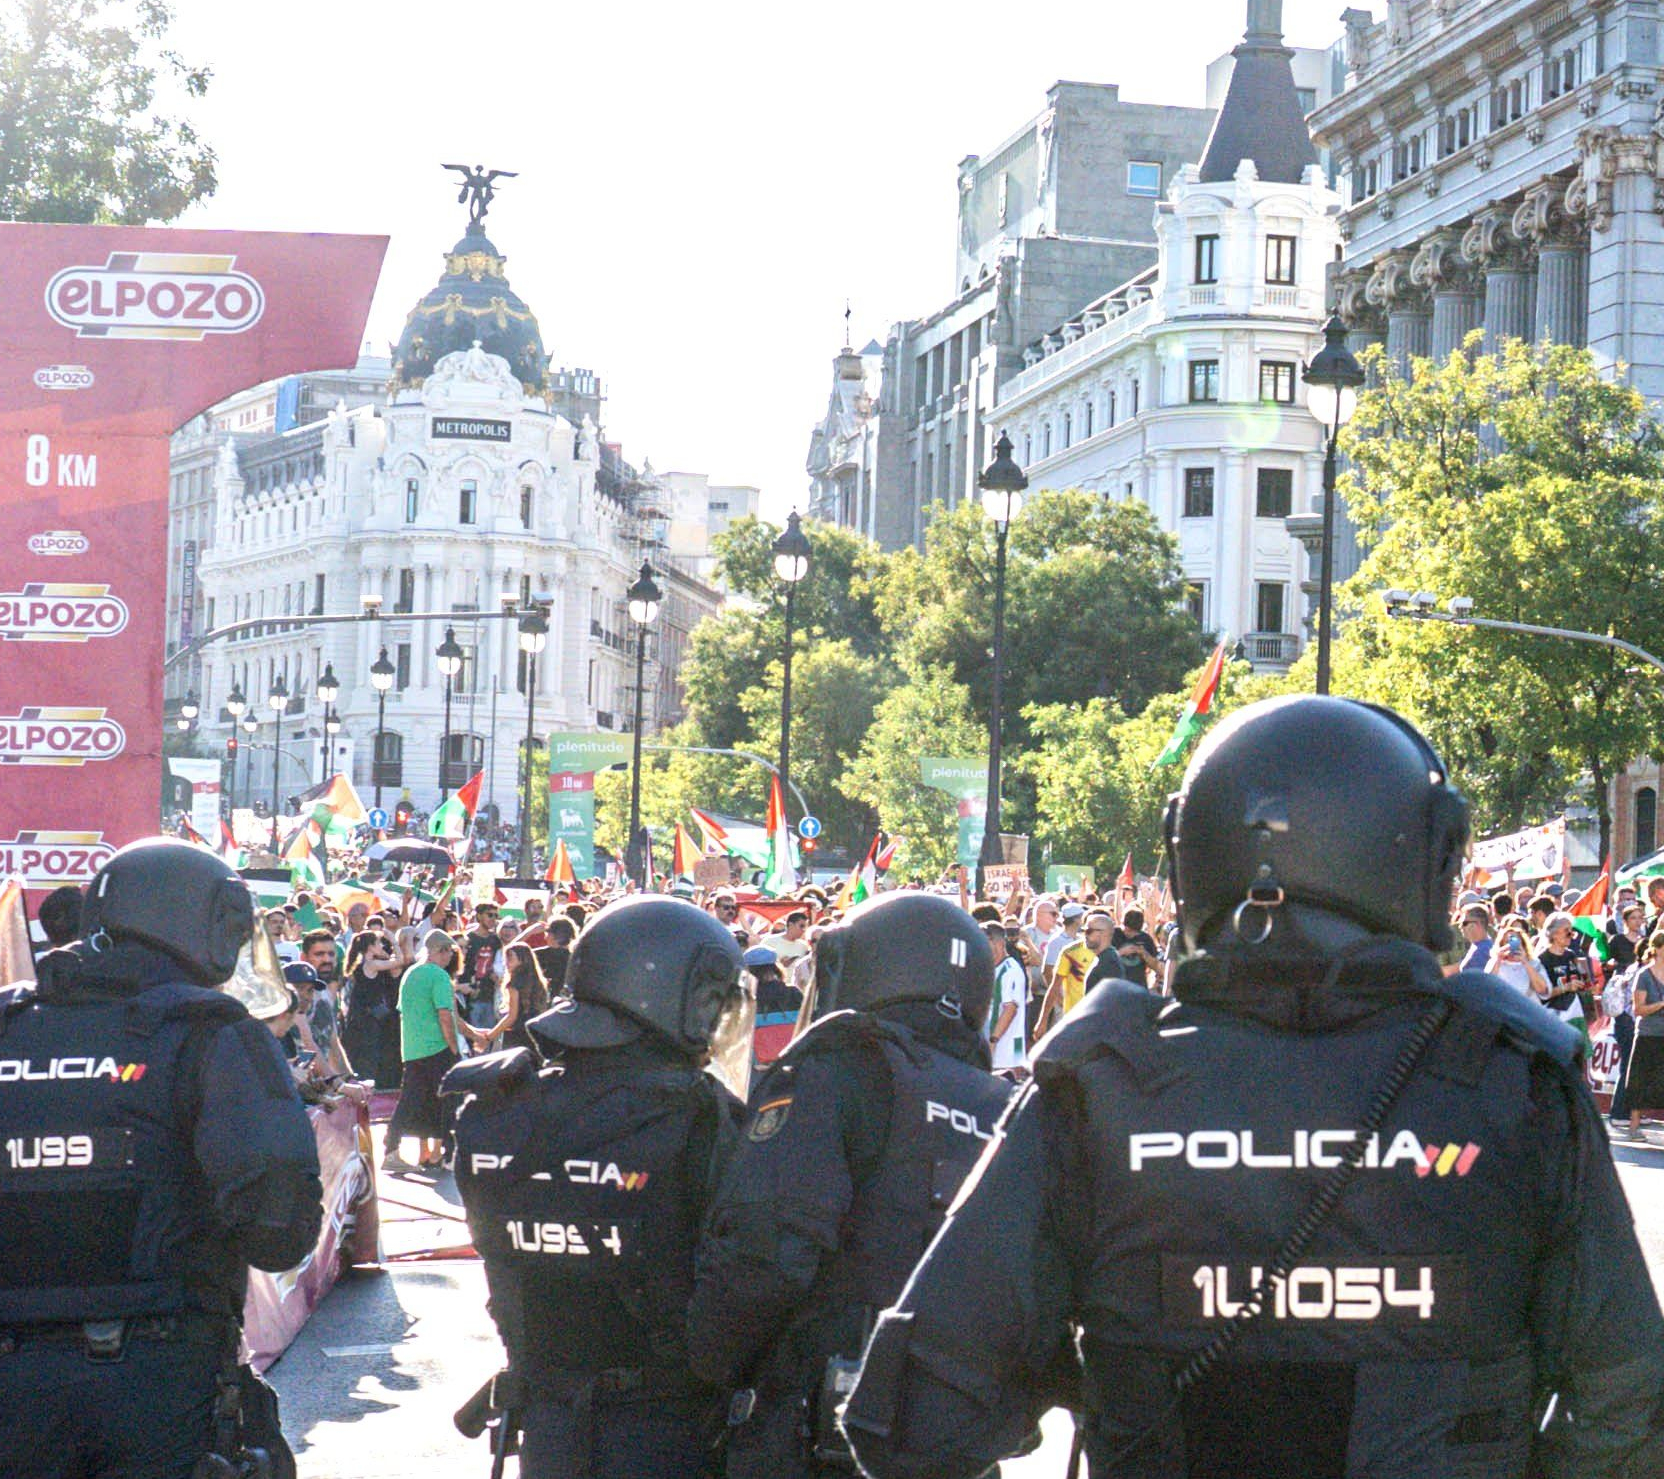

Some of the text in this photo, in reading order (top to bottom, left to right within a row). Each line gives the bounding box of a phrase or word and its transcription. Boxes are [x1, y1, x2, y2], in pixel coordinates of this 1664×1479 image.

[436, 421, 508, 437] METROPOLIS
[25, 433, 97, 488] 8 KM
[556, 740, 625, 754] plenitude
[931, 766, 988, 779] plenitud
[5, 1134, 94, 1169] 1U99
[1129, 1129, 1431, 1171] POLICIA
